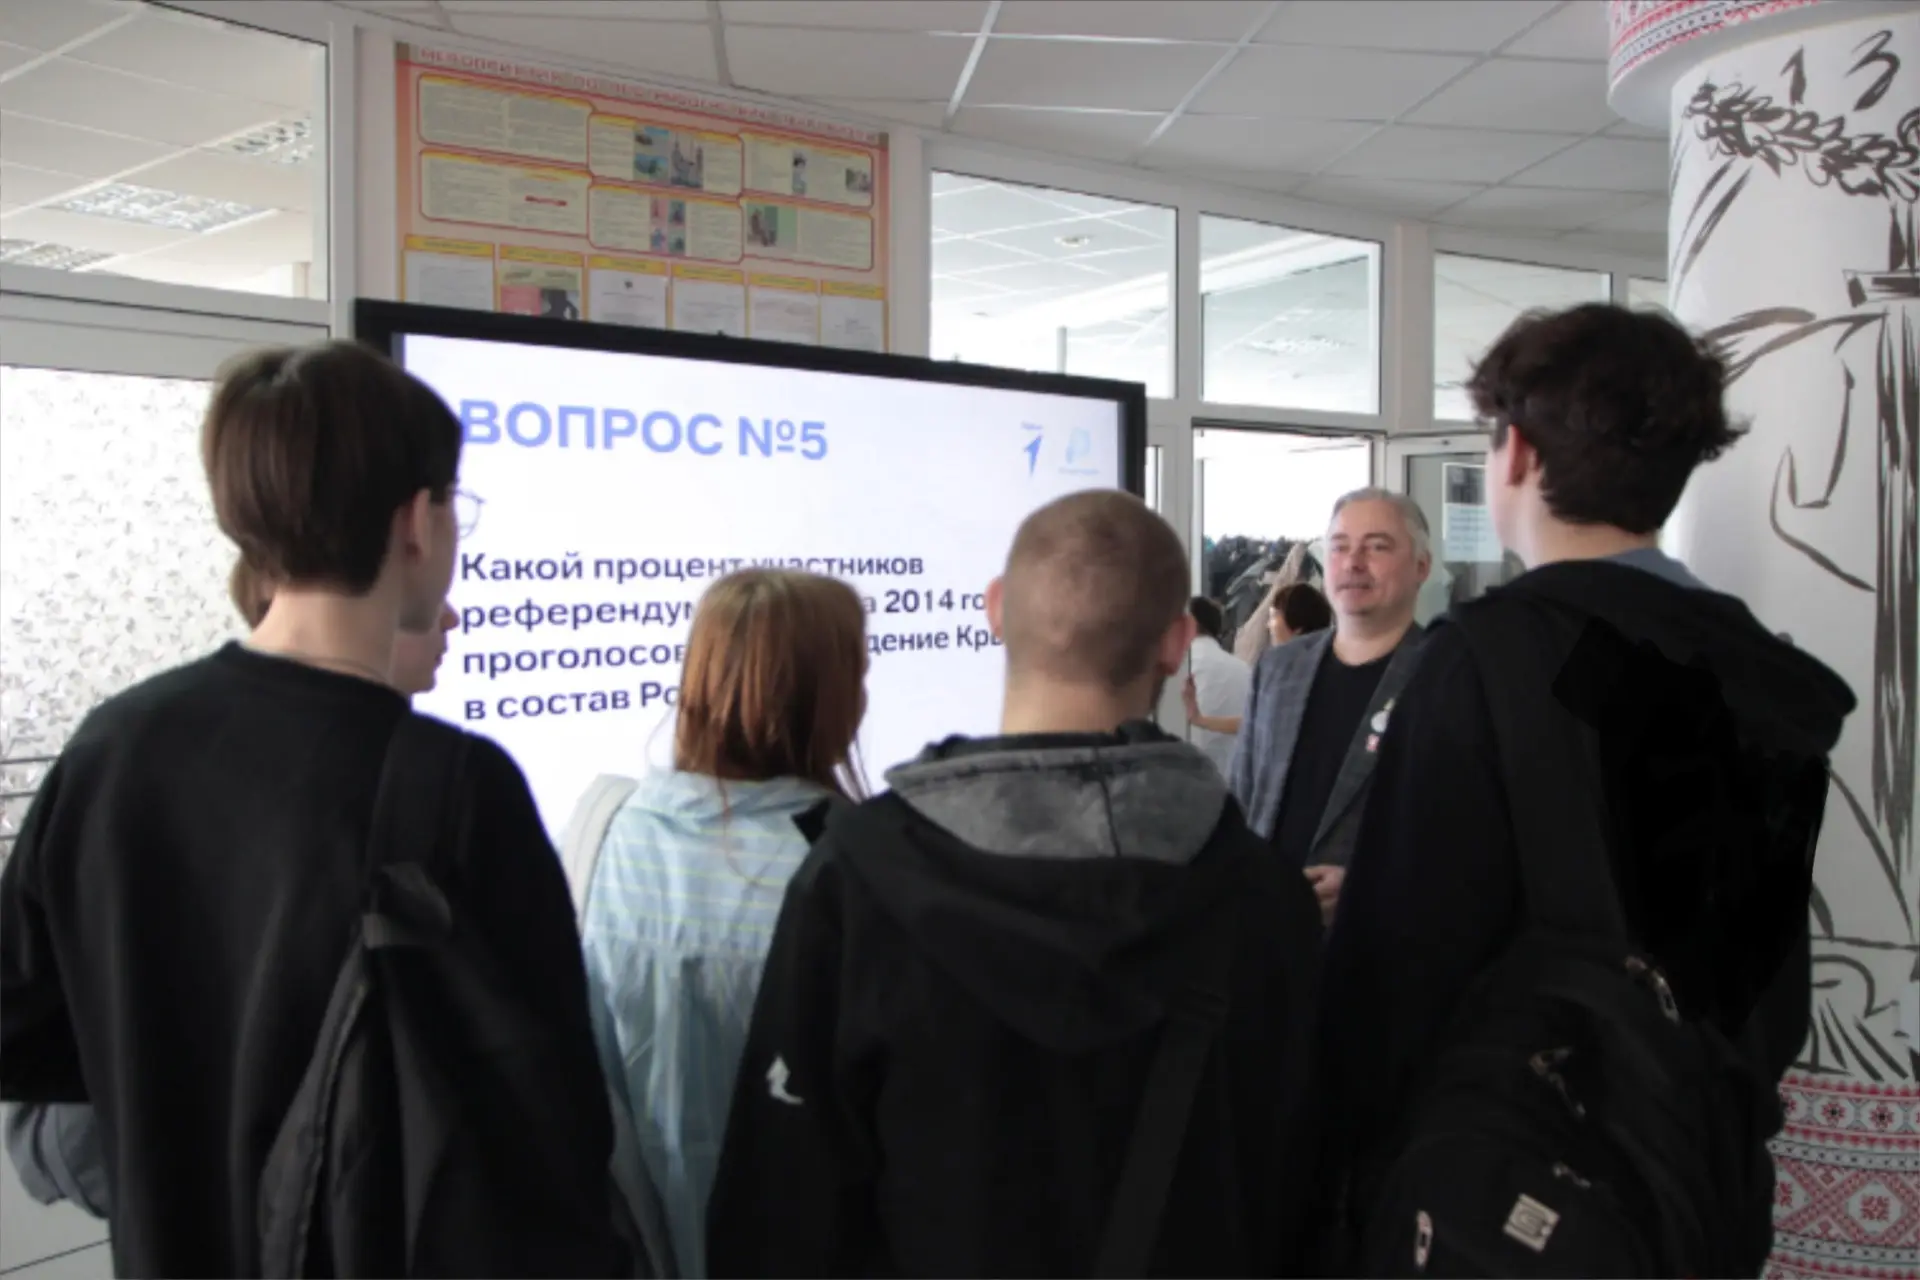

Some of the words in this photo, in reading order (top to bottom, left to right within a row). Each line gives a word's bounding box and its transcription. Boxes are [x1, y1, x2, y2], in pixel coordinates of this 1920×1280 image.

[460, 399, 723, 456] ВОПРОС
[738, 416, 828, 460] №5
[461, 551, 583, 581] Какой
[593, 557, 743, 585] процент
[884, 588, 956, 613] 2014
[465, 700, 486, 720] в
[497, 690, 630, 719] состав
